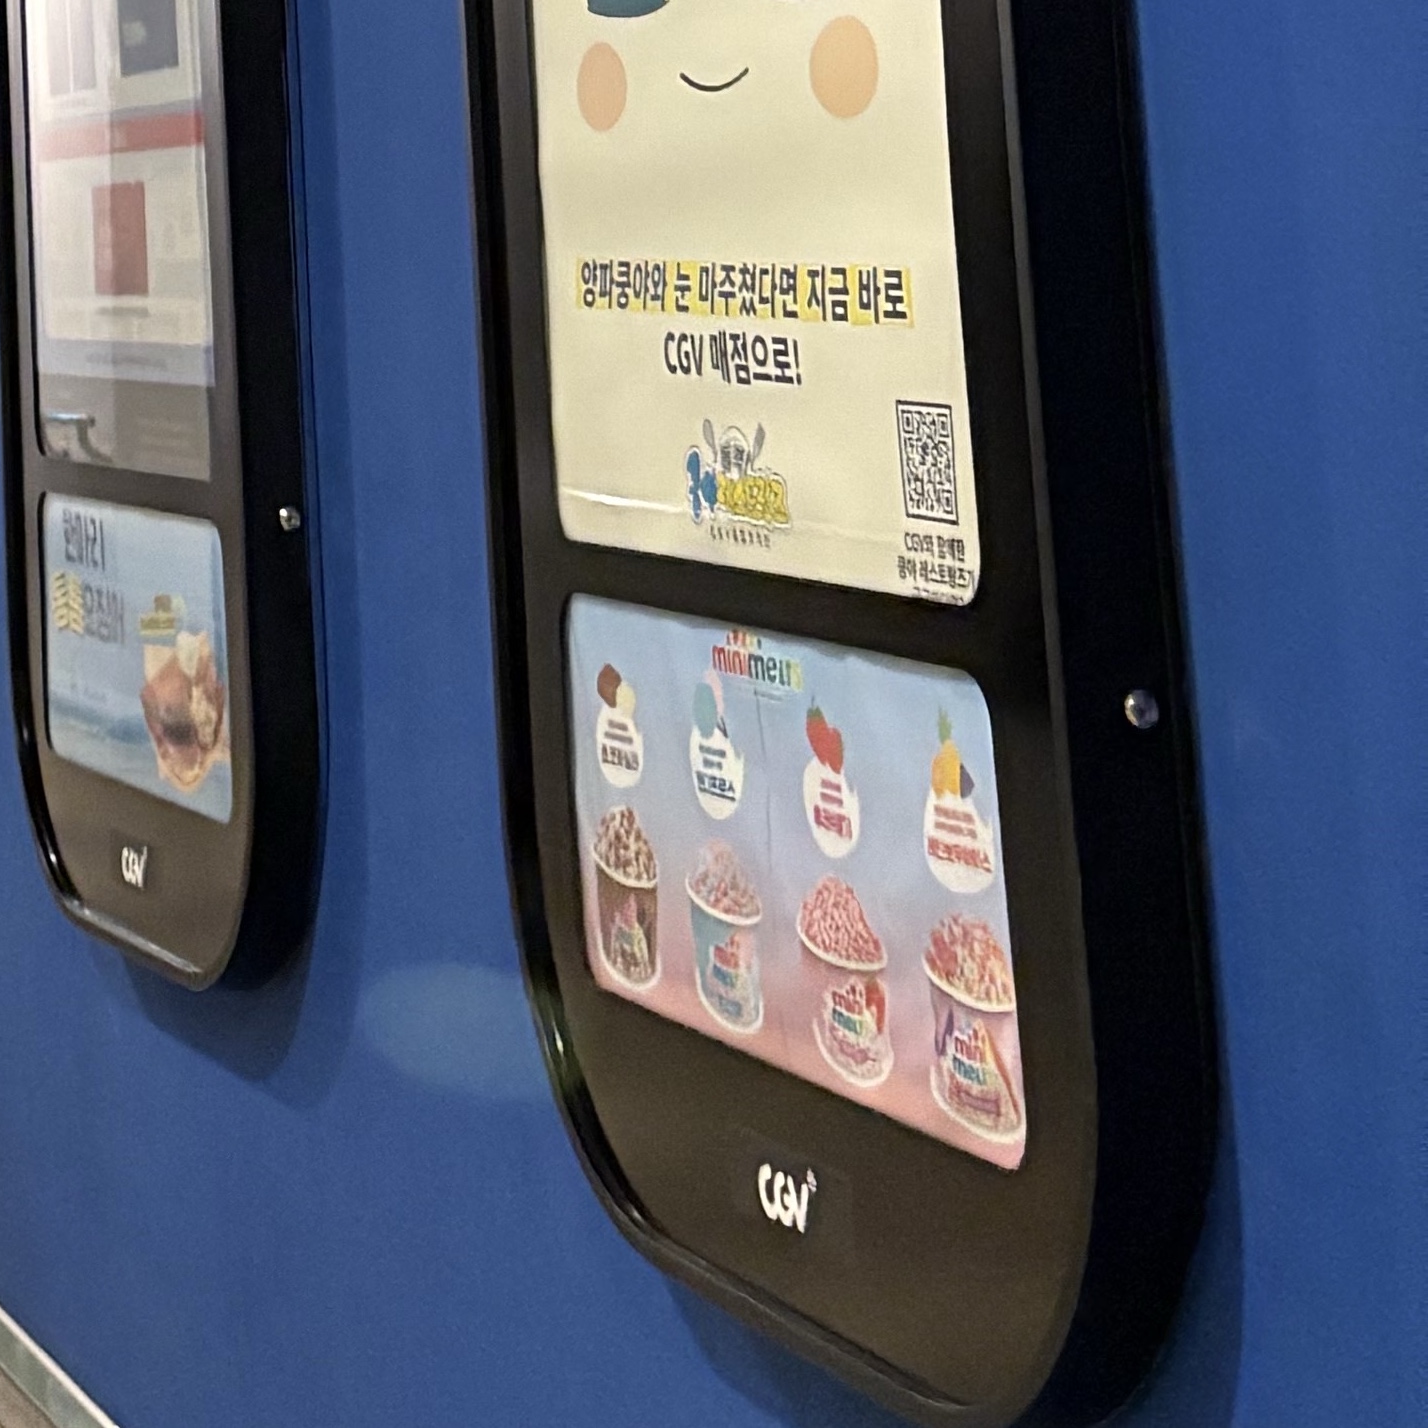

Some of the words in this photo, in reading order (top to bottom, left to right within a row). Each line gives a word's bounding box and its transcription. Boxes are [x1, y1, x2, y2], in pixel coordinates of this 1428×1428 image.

[581, 259, 668, 312] 양파쿵야와
[674, 261, 692, 313] 눈
[698, 261, 799, 318] 마주쳤다면
[807, 264, 850, 322] 지금
[858, 266, 909, 325] 바로
[664, 331, 704, 376] CGV
[708, 329, 802, 386] 매점으로!
[758, 1163, 809, 1235] CGV
